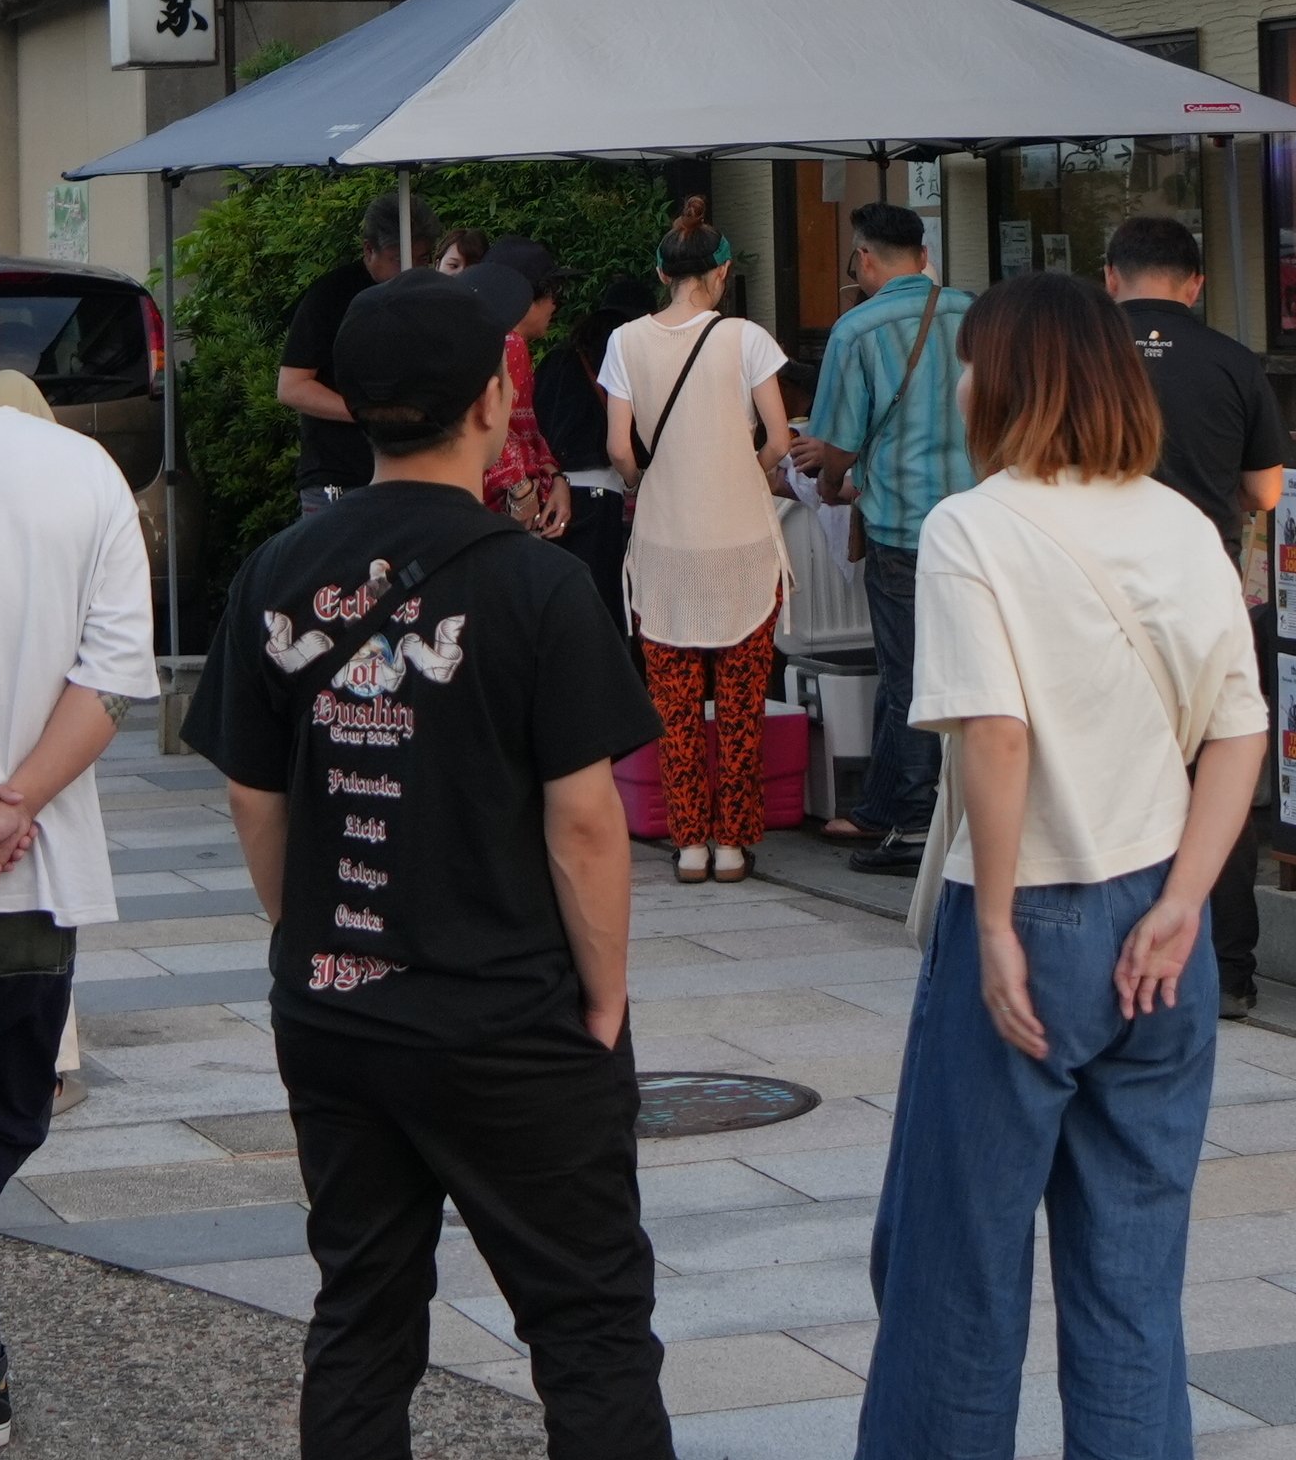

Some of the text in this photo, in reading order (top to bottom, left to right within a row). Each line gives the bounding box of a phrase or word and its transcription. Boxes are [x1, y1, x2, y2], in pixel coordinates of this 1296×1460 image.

[313, 583, 422, 623] Echs
[350, 656, 383, 687] of
[312, 690, 414, 739] Duality
[330, 724, 365, 744] Tour
[327, 768, 402, 799] Fukuoka
[343, 814, 387, 843] Aichi
[338, 856, 389, 890] Tokyo
[334, 902, 384, 933] Osaka
